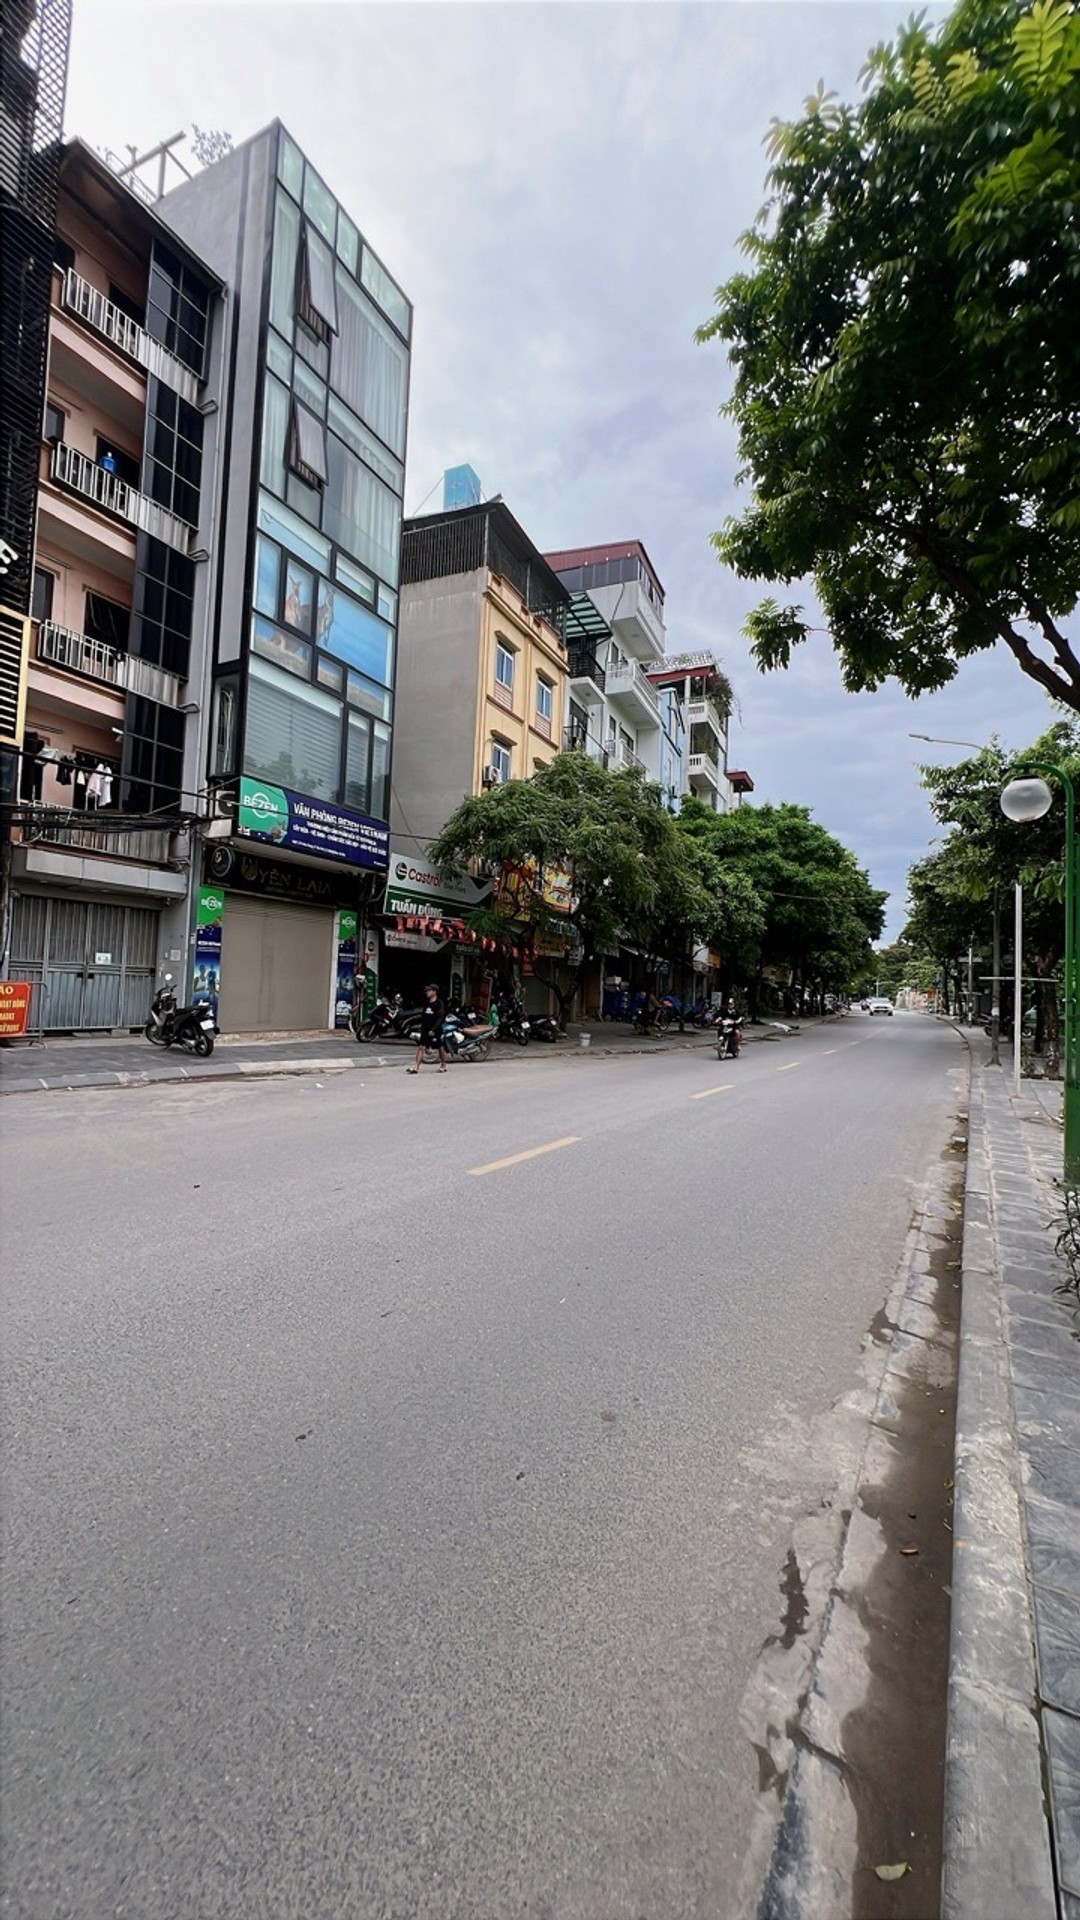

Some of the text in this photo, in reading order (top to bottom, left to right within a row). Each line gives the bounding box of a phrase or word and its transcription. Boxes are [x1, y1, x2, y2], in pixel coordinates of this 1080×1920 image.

[243, 795, 279, 812] BEZEN
[310, 808, 337, 824] PHÒNG
[391, 898, 417, 915] TUẤN
